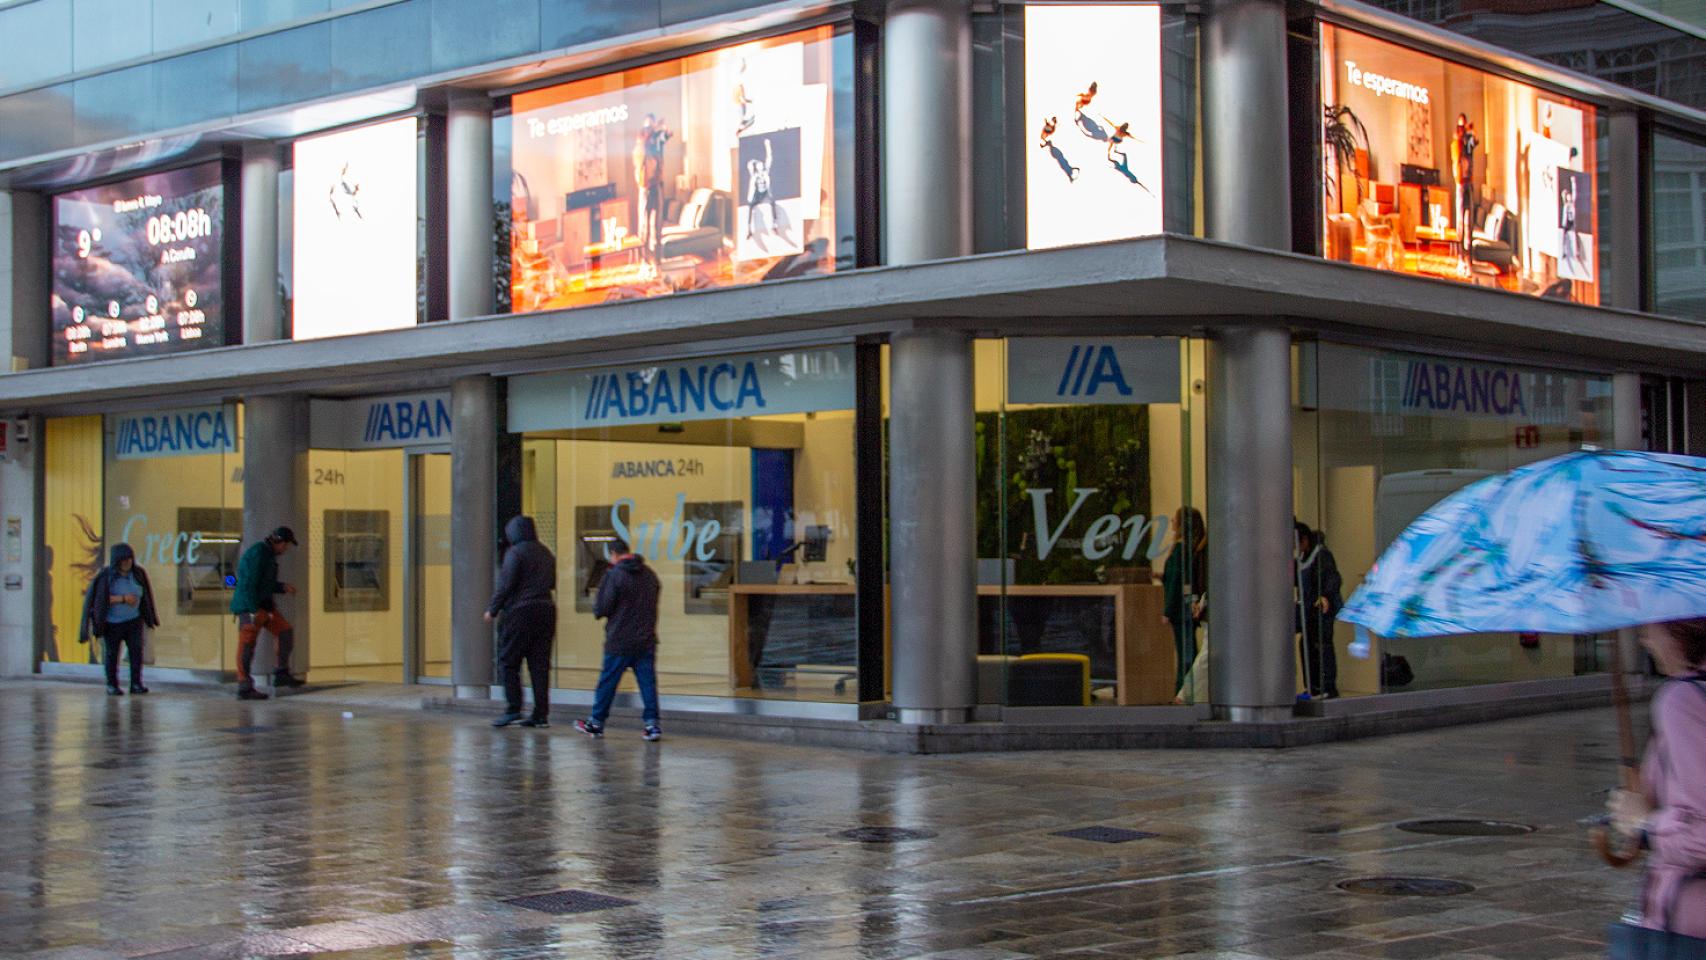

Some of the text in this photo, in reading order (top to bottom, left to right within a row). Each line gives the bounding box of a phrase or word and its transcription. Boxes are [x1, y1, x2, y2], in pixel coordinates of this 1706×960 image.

[1344, 60, 1429, 105] Te esperamos
[527, 104, 629, 139] Te esperamos
[148, 208, 212, 246] 08:08h
[314, 468, 345, 485] 24h
[678, 459, 704, 476] 24h
[603, 491, 721, 562] Sube
[1026, 488, 1176, 561] Ven
